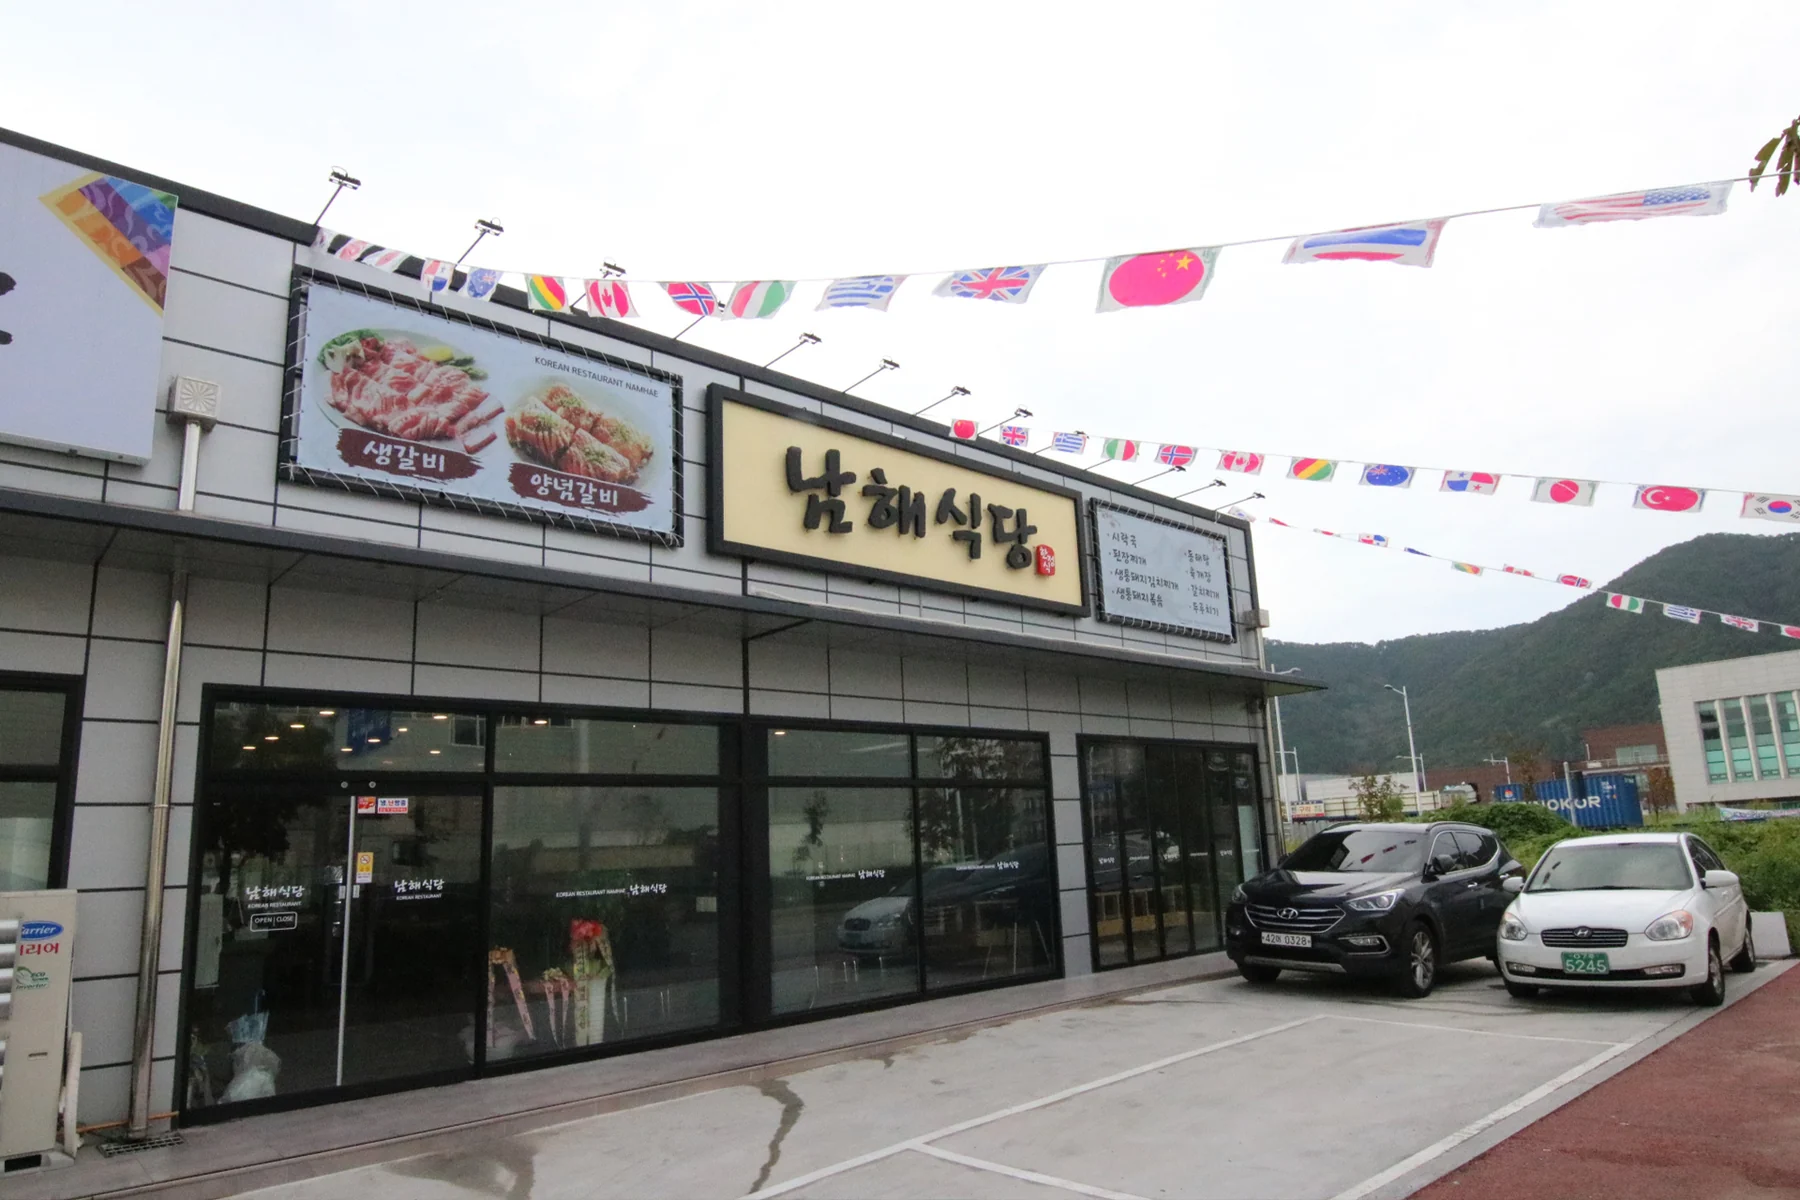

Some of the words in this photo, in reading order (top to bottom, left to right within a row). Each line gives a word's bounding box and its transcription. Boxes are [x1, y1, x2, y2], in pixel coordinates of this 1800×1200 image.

[534, 356, 570, 373] KOREAN
[571, 367, 623, 388] RESTAURANT
[625, 382, 659, 398] NAMHAE
[362, 439, 445, 473] 생갈비
[530, 473, 619, 506] 양념갈비
[785, 446, 1038, 569] 남해식당
[1112, 532, 1137, 548] 시락국
[1112, 549, 1147, 565] 된장찌개
[1187, 550, 1210, 566] 동태탕
[1189, 567, 1211, 583] 육개장
[1190, 584, 1220, 599] 갈치찌개
[1193, 602, 1219, 617] 두루치기
[245, 885, 306, 900] 남해식당
[394, 878, 445, 893] 남해식당
[629, 883, 667, 896] 남해식당
[21, 925, 57, 935] arrier
[1284, 935, 1307, 946] 0328
[1565, 959, 1607, 972] 5245
